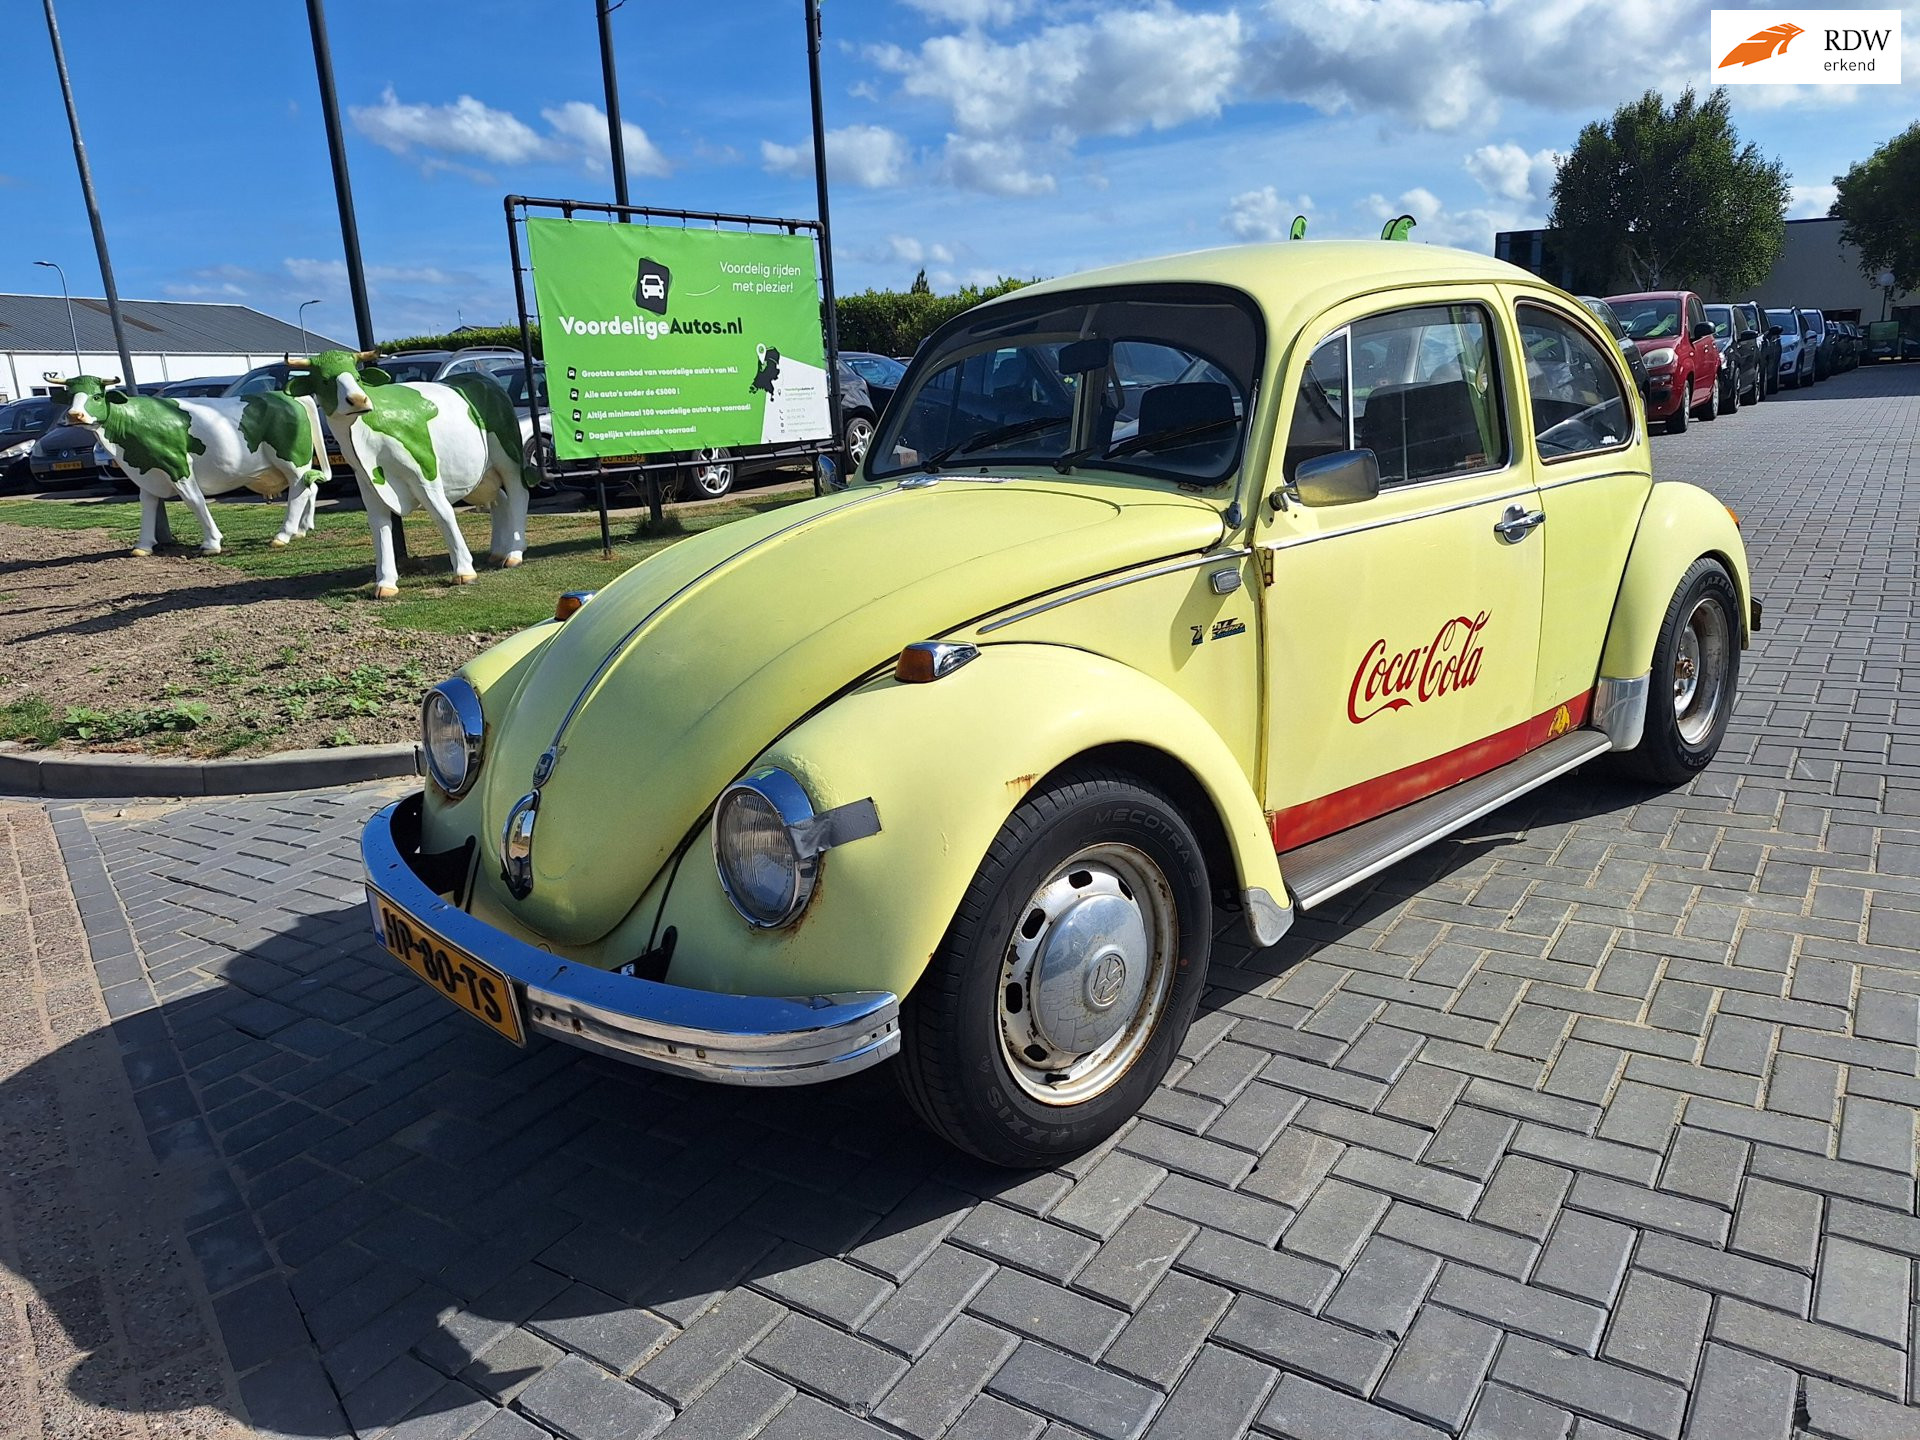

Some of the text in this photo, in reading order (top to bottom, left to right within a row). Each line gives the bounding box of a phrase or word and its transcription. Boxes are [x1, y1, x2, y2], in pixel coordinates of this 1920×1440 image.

[720, 261, 801, 278] Voordelig rijden
[732, 280, 793, 294] met plezier!
[559, 316, 743, 340] VoordeligeAutos.nl
[581, 370, 615, 378] Grootste
[616, 368, 644, 376] aanbod
[658, 367, 694, 376] voordelige
[694, 366, 714, 374] auto's
[727, 366, 738, 374] NL!
[584, 390, 599, 398] Alle
[600, 389, 623, 398] auto's
[623, 389, 645, 397] onder
[645, 388, 655, 396] de
[586, 410, 607, 420] Altijd
[607, 409, 642, 418] minimaal
[655, 406, 691, 415] voordelige
[691, 405, 712, 413] auto's
[721, 403, 751, 411] voorraad!
[588, 425, 697, 440] Dagelijks wisselende voorraad!
[1093, 808, 1192, 864] MECOTRA
